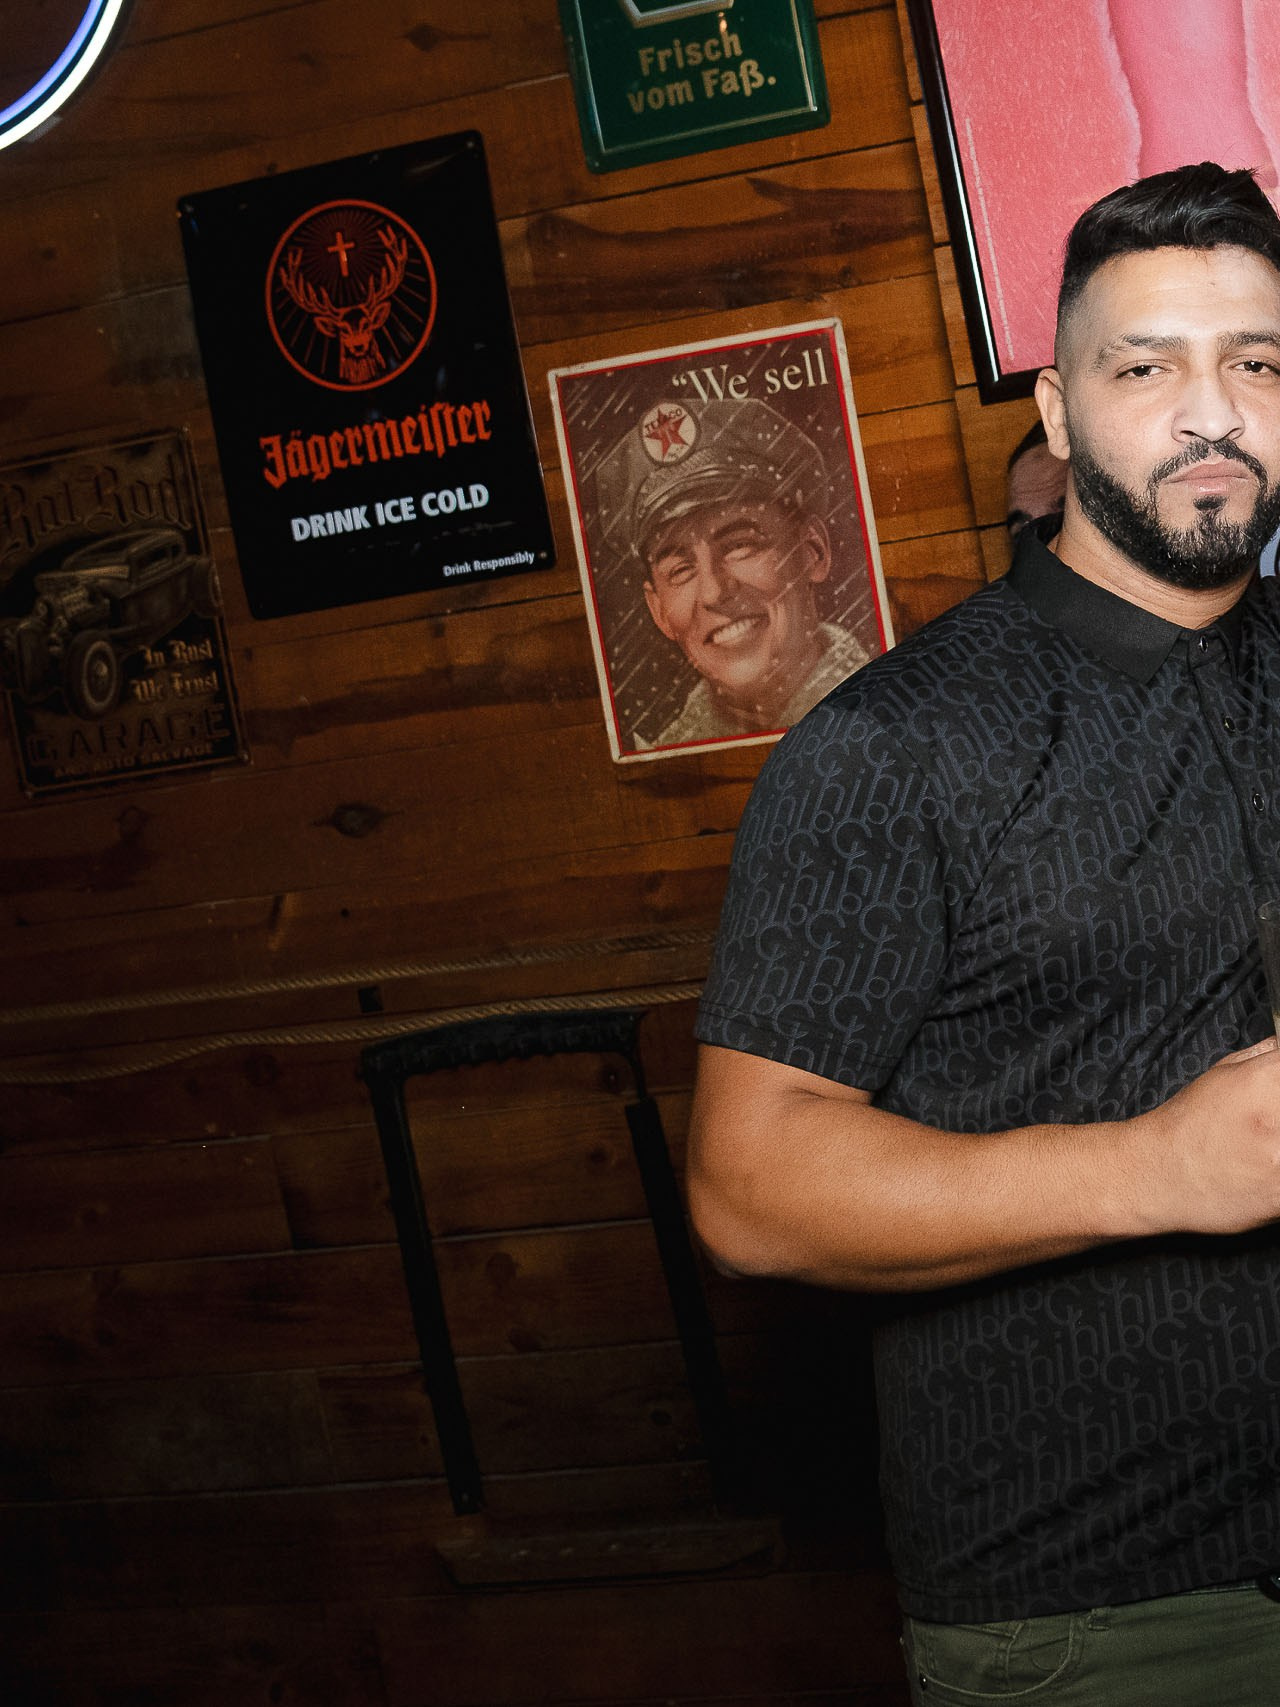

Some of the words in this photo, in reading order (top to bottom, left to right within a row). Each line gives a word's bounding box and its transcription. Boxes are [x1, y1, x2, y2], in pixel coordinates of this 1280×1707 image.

[637, 28, 742, 76] Frisch
[627, 79, 694, 114] vom
[701, 59, 776, 98] Faß.
[764, 348, 830, 395] sell
[291, 505, 372, 542] DRINK
[375, 497, 417, 526] ICE
[421, 483, 490, 517] COLD
[442, 563, 472, 577] Drink
[473, 551, 535, 573] Responsibly
[26, 703, 231, 766] GARAGE
